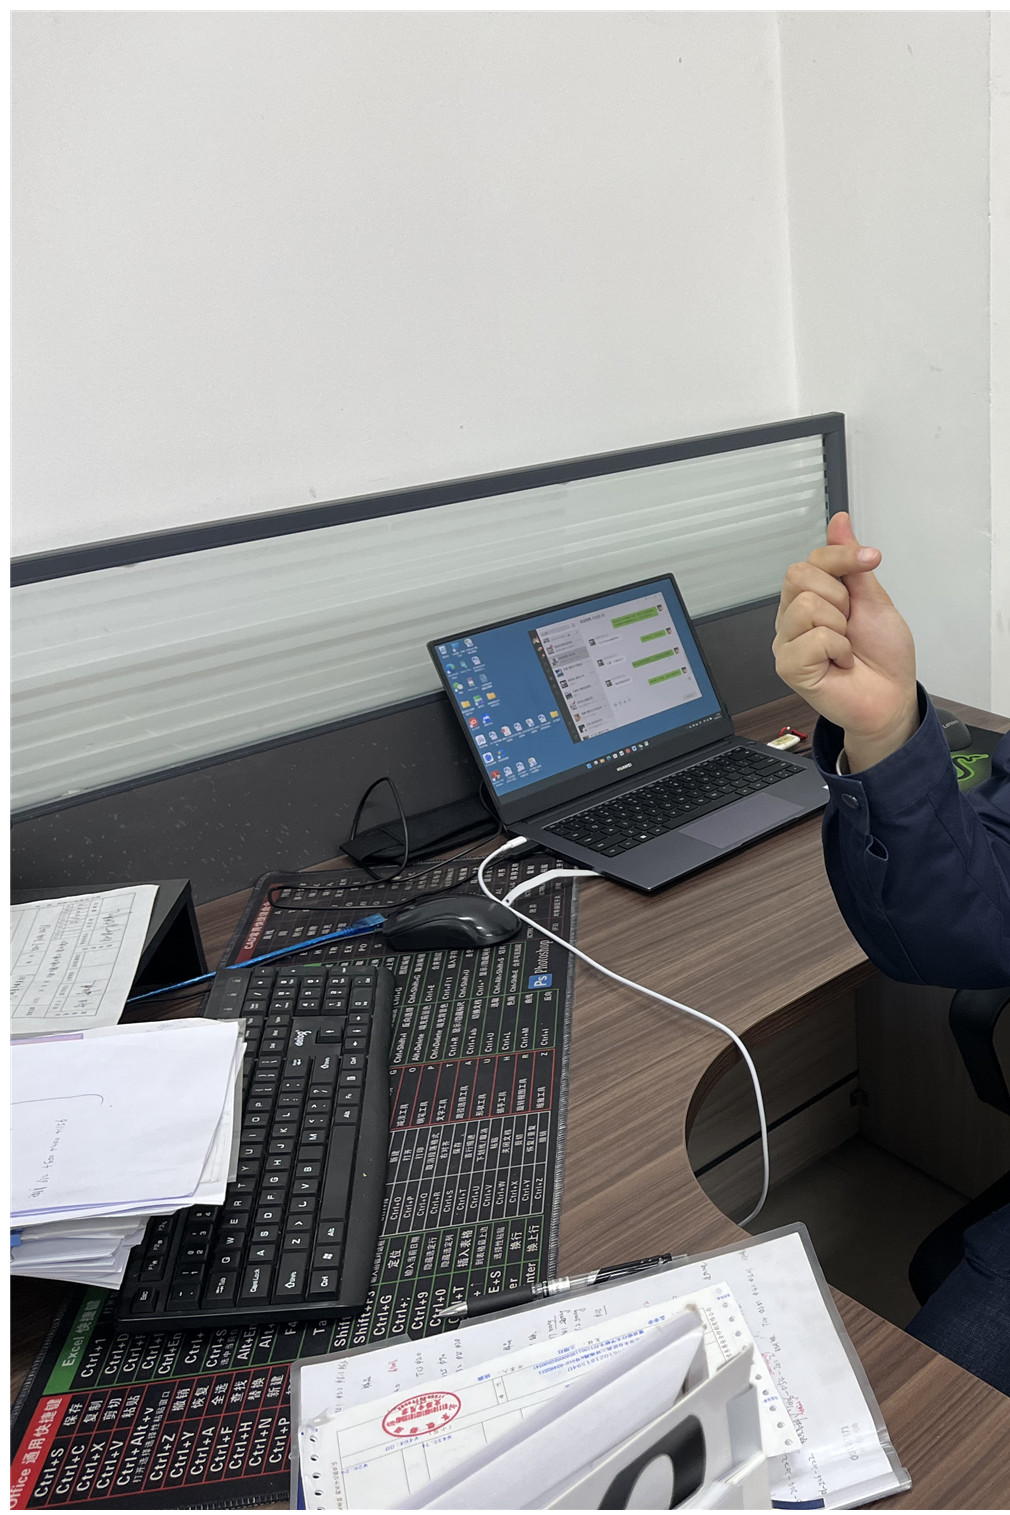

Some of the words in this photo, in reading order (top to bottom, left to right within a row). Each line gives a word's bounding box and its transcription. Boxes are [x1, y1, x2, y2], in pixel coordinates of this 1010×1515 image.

[534, 940, 553, 974] Photoshop
[534, 976, 548, 988] Ps
[412, 1034, 425, 1062] Alt+Delete
[430, 1030, 443, 1060] Ctrl+Delete
[448, 1036, 459, 1057] Ctrl+R
[466, 1028, 478, 1055] Ctrl+Tab
[484, 1032, 495, 1052] Ctrl+U
[502, 1032, 511, 1050] Ctrl+L
[520, 1027, 530, 1048] Ctrl+M
[436, 1099, 448, 1122] 文字工具
[403, 1149, 412, 1161] 打开
[415, 1147, 425, 1160] 打印
[440, 1141, 450, 1159] 右对齐
[453, 1142, 462, 1154] 保存
[456, 1188, 467, 1210] Ctrl+T
[470, 1185, 480, 1208] Ctrl+U
[483, 1184, 493, 1207] Ctrl+V
[496, 1181, 506, 1205] Ctrl+W
[509, 1180, 518, 1203] Ctrl+X
[522, 1179, 531, 1201] Ctrl+Y
[534, 1177, 544, 1199] Ctrl+Z
[390, 1196, 401, 1220] Ctrl+O
[403, 1195, 414, 1219] Ctrl+P
[417, 1192, 428, 1216] Ctrl+Q
[430, 1191, 441, 1215] Ctrl+R
[443, 1189, 453, 1212] Ctrl+S
[457, 1229, 473, 1268] 插入表格
[510, 1232, 523, 1250] 换行
[527, 1225, 540, 1252] 换上行
[387, 1249, 401, 1269] 定位
[404, 1236, 420, 1277] 输入当前日期
[373, 1294, 392, 1336] Ctrl+G
[411, 1291, 429, 1330] Ctrl+9
[62, 1336, 85, 1367] Excel
[75, 1300, 100, 1334] 快捷键
[81, 1338, 106, 1378] Ctrl+1
[104, 1333, 129, 1374] Ctrl+D
[191, 1385, 210, 1409] 恢复
[211, 1383, 228, 1406] 全选
[230, 1380, 248, 1403] 查找
[248, 1377, 266, 1401] 替换
[267, 1374, 284, 1398] 新建
[83, 1400, 103, 1423] 复制
[102, 1398, 122, 1421] 剪切
[121, 1395, 140, 1419] 粘贴
[172, 1388, 190, 1412] 撤销
[63, 1402, 83, 1426] 保存
[22, 1398, 62, 1464] 通用快捷键
[248, 1417, 272, 1466] Ctrl+N
[269, 1417, 290, 1464] Ctrl+P
[150, 1433, 176, 1481] Ctrl+Z
[170, 1431, 194, 1478] Ctrl+Y
[190, 1426, 215, 1476] Ctrl+A
[210, 1426, 233, 1472] Ctrl+F
[229, 1421, 252, 1470] Ctrl+H
[34, 1447, 64, 1498] Ctrl+S
[56, 1445, 85, 1494] Ctrl+C
[76, 1441, 106, 1491] Ctrl+X
[96, 1440, 124, 1489] Ctrl+V
